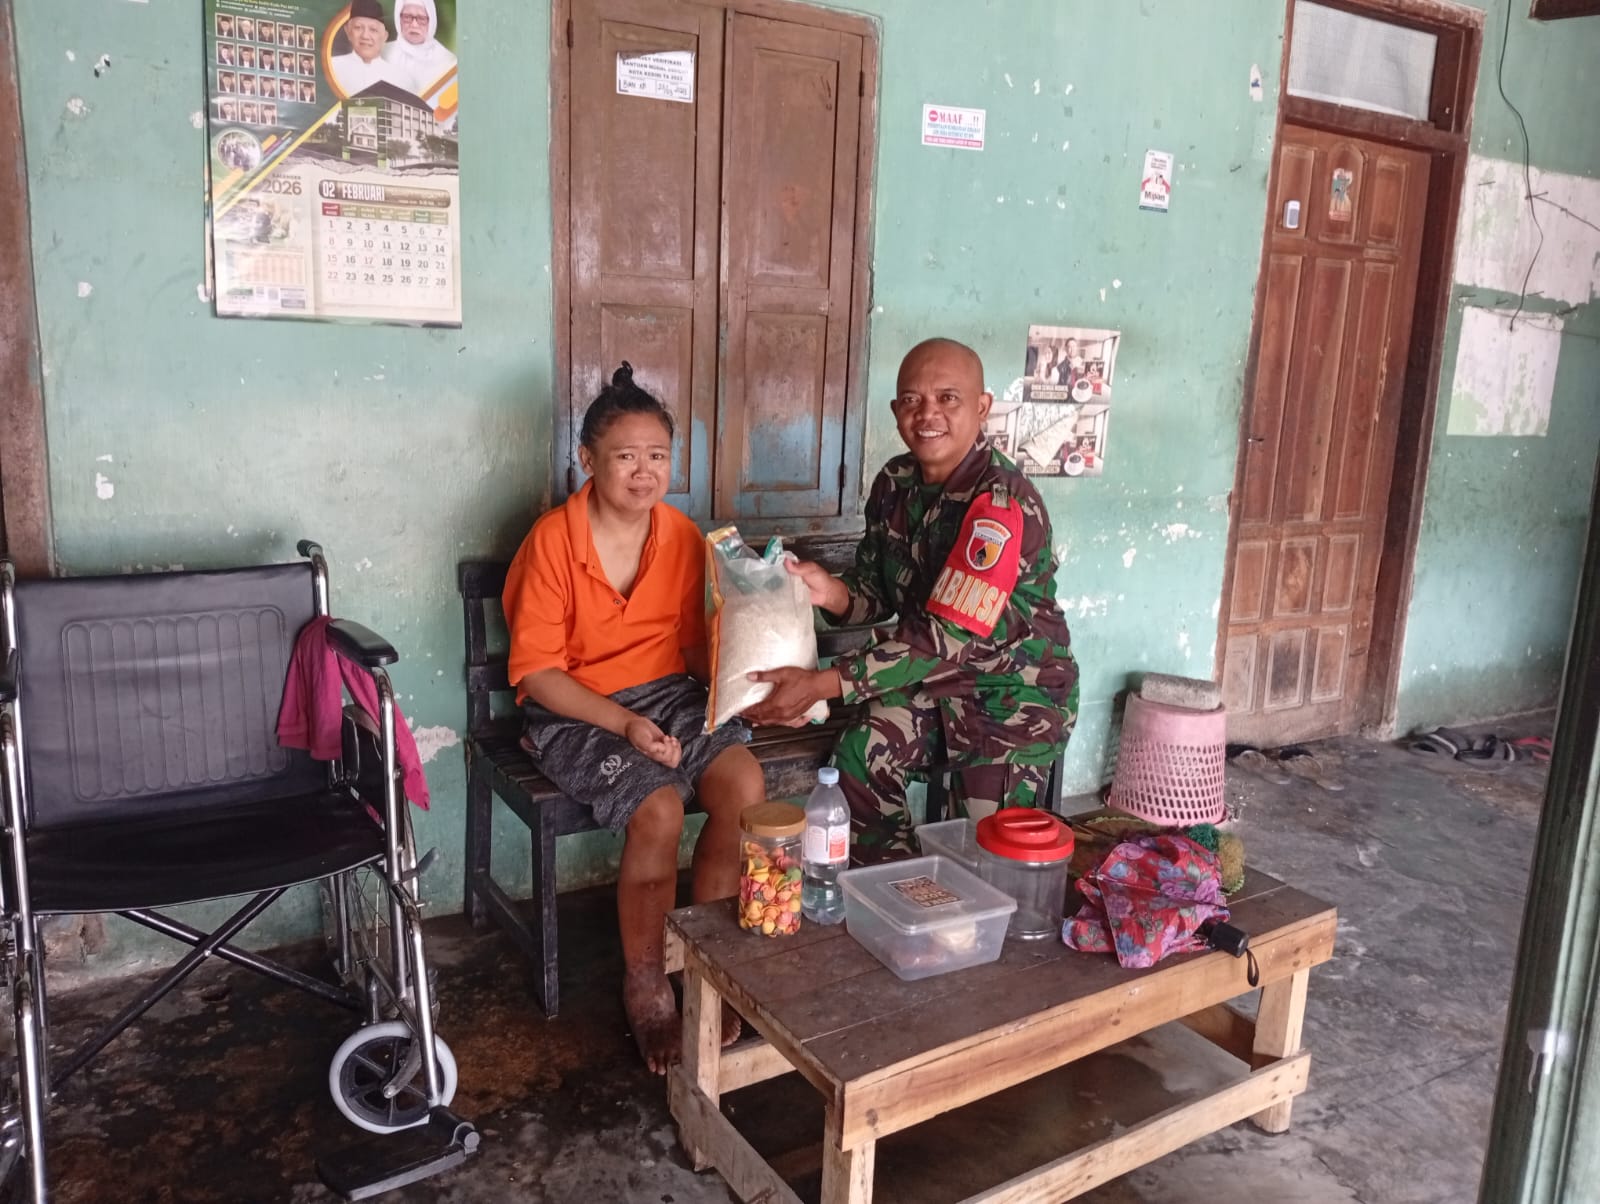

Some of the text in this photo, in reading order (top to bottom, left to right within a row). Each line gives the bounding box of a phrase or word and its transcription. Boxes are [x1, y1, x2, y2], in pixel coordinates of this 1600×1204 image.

[622, 61, 648, 69] BANTUAN
[939, 112, 963, 124] MAAF
[262, 179, 302, 196] 2026
[322, 181, 336, 198] 02
[341, 183, 386, 202] FEBRUARI
[329, 220, 443, 237] 1 2 3 4 5 6 7
[328, 237, 445, 254] 8 9 10 11 12 13 14
[327, 254, 445, 270] 15 16 17 18 19 20 21
[327, 271, 447, 287] 22 23 24 25 26 27 28
